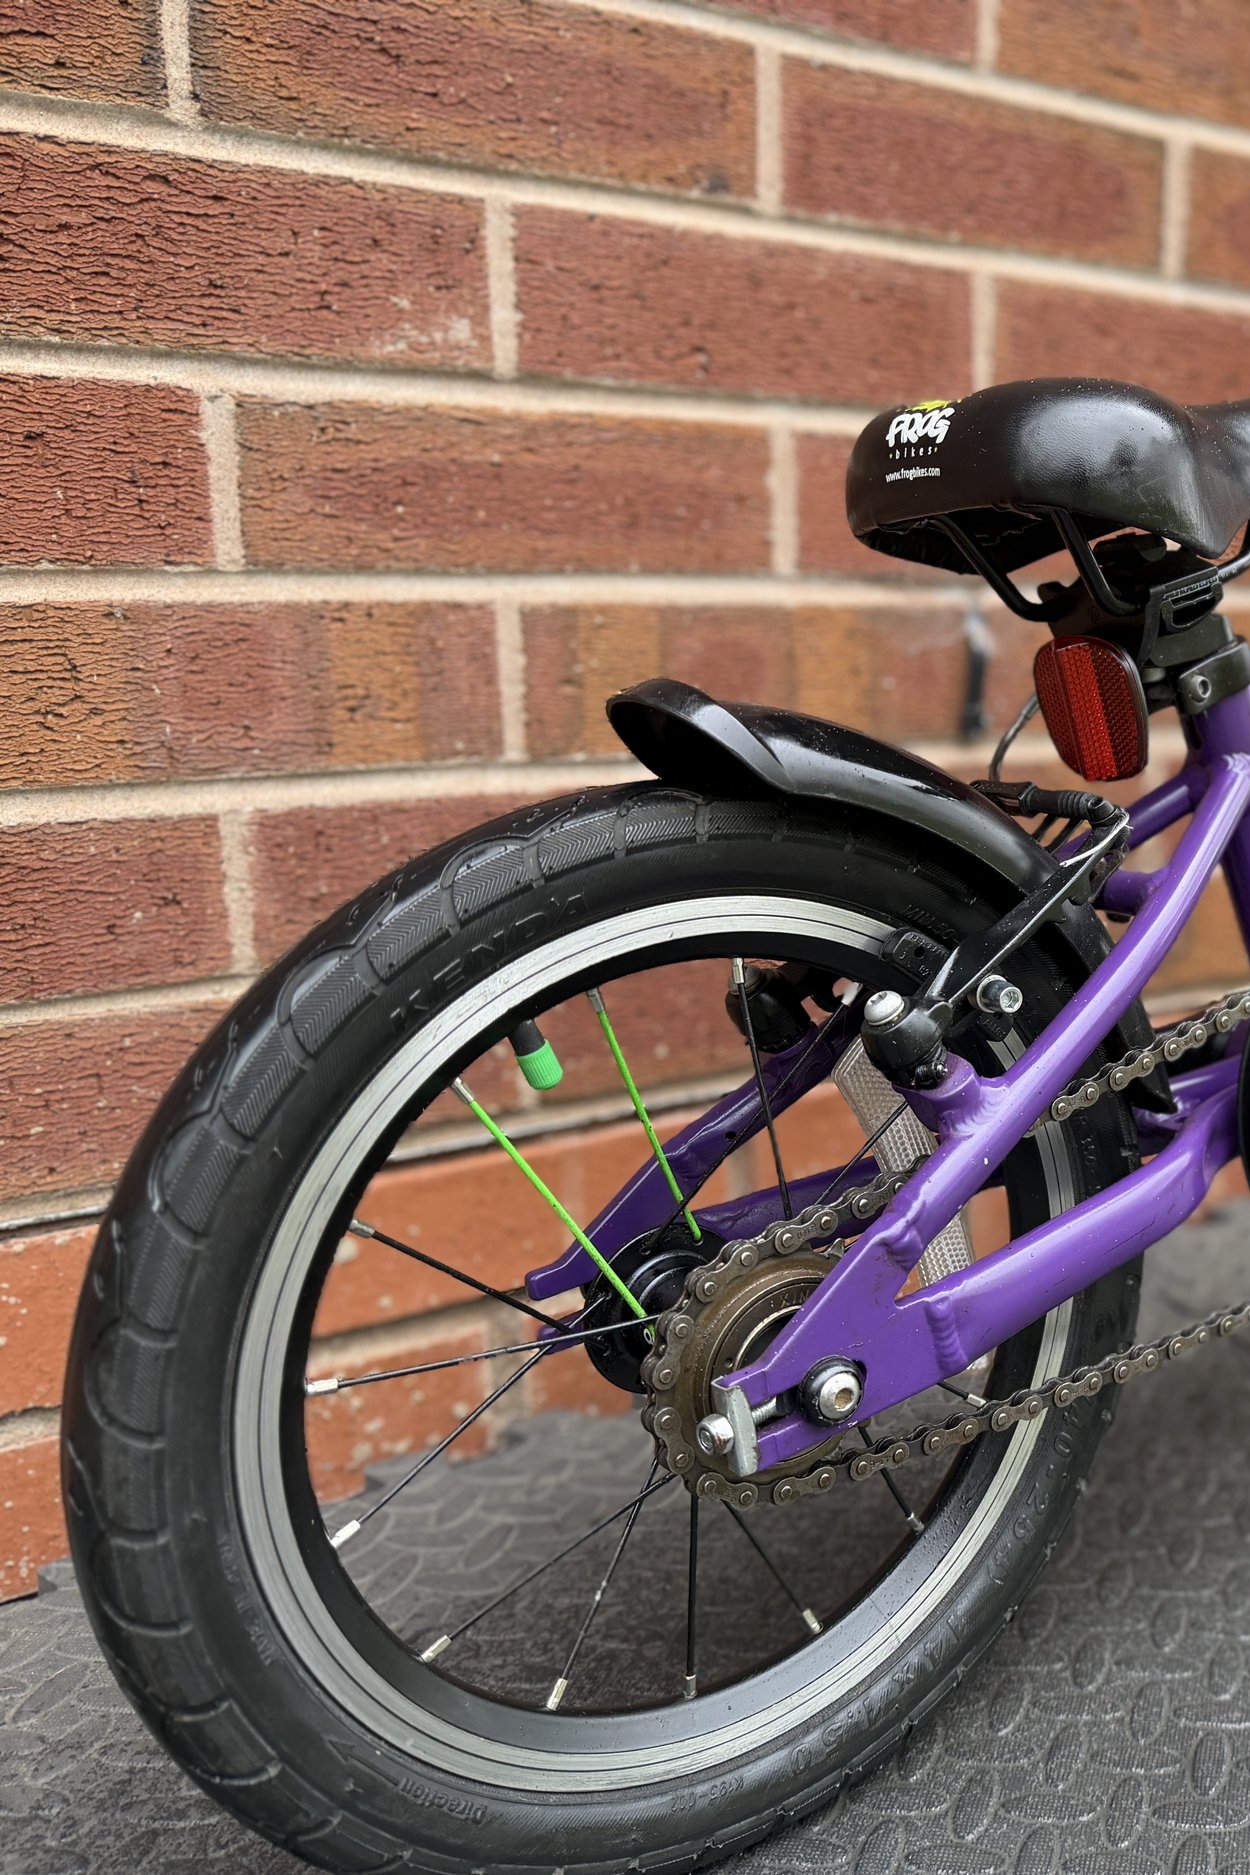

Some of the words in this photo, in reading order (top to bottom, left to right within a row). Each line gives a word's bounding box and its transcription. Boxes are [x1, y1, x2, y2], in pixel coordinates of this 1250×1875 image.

[885, 407, 956, 447] FROG
[895, 446, 933, 460] bikes
[885, 466, 941, 483] www.frogbikes.com
[389, 892, 589, 1035] KENDA
[398, 1778, 488, 1825] Direction
